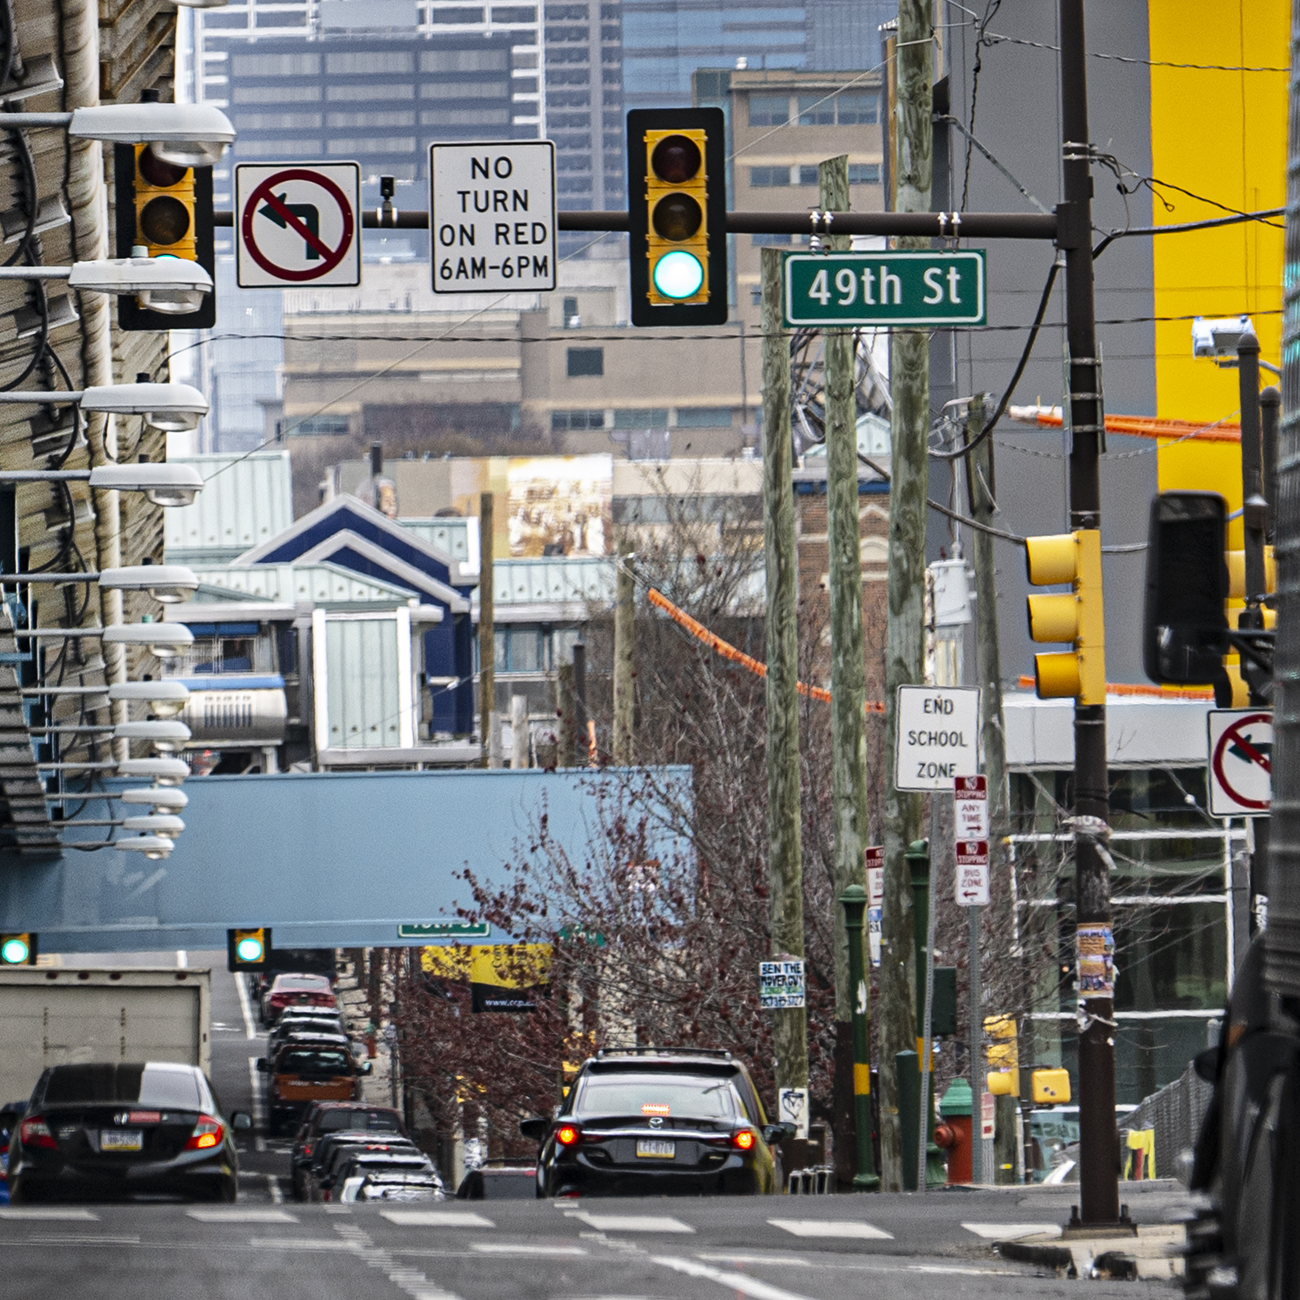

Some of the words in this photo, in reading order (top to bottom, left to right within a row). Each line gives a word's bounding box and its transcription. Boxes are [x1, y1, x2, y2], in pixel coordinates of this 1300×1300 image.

[471, 156, 513, 179] NO
[457, 189, 528, 213] TURN
[440, 224, 475, 247] ON
[495, 222, 547, 245] RED
[440, 255, 548, 280] 6AM-6PM
[808, 266, 902, 306] 49th
[923, 266, 962, 305] St
[923, 699, 954, 715] END
[908, 730, 968, 748] SCHOOL
[917, 762, 957, 778] ZONE
[962, 804, 980, 812] ANY
[784, 963, 801, 974] THE
